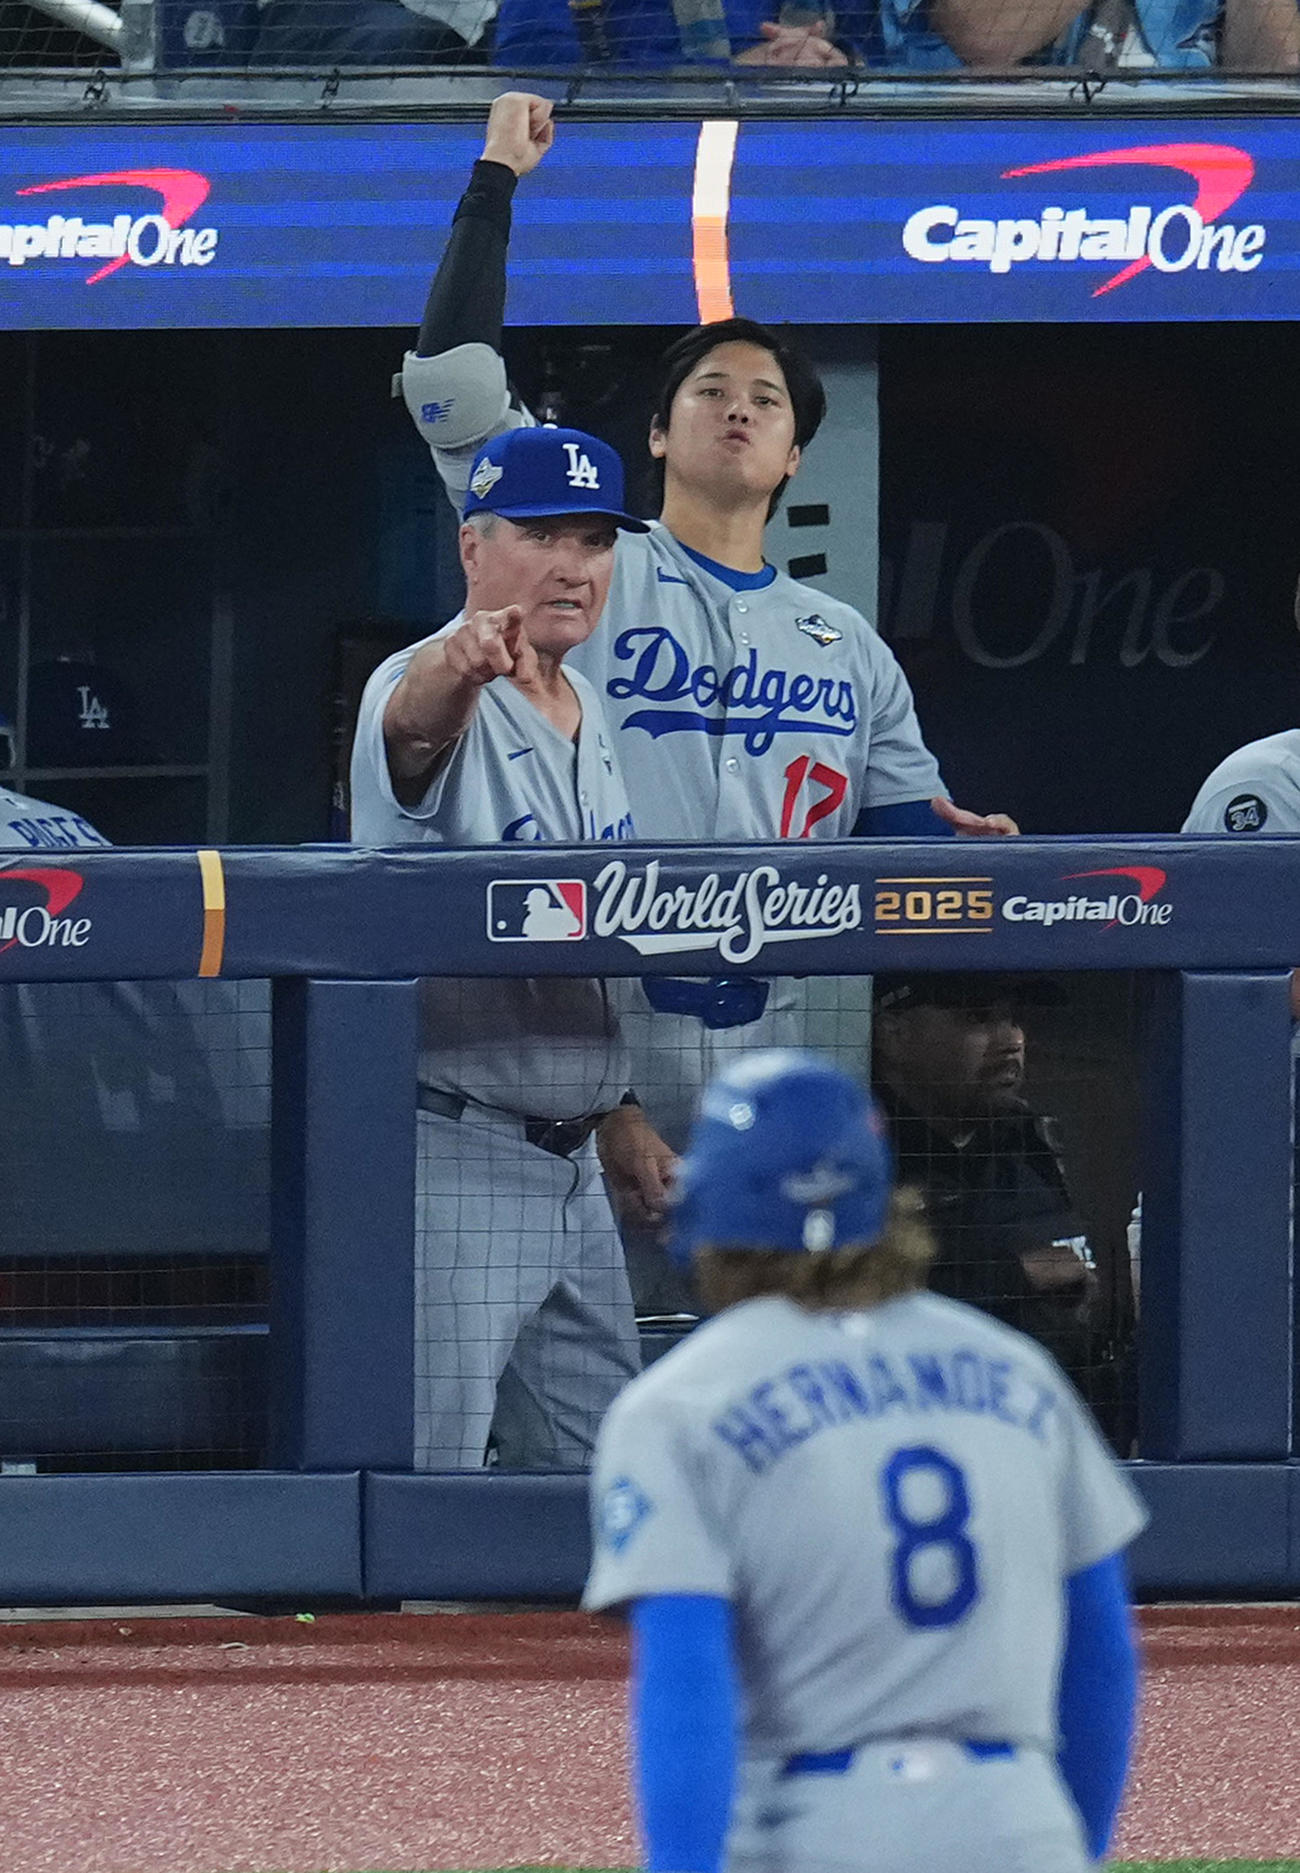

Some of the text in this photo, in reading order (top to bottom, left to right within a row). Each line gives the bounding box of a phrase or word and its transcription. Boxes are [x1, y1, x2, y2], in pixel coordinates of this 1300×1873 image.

[562, 443, 600, 489] LA
[77, 686, 110, 728] LA
[606, 626, 857, 758] Dodgers
[780, 755, 849, 839] 17
[1231, 807, 1259, 831] 34
[874, 890, 994, 921] 2025
[711, 1347, 1057, 1474] HERNANDEZ
[880, 1445, 979, 1630] 8
